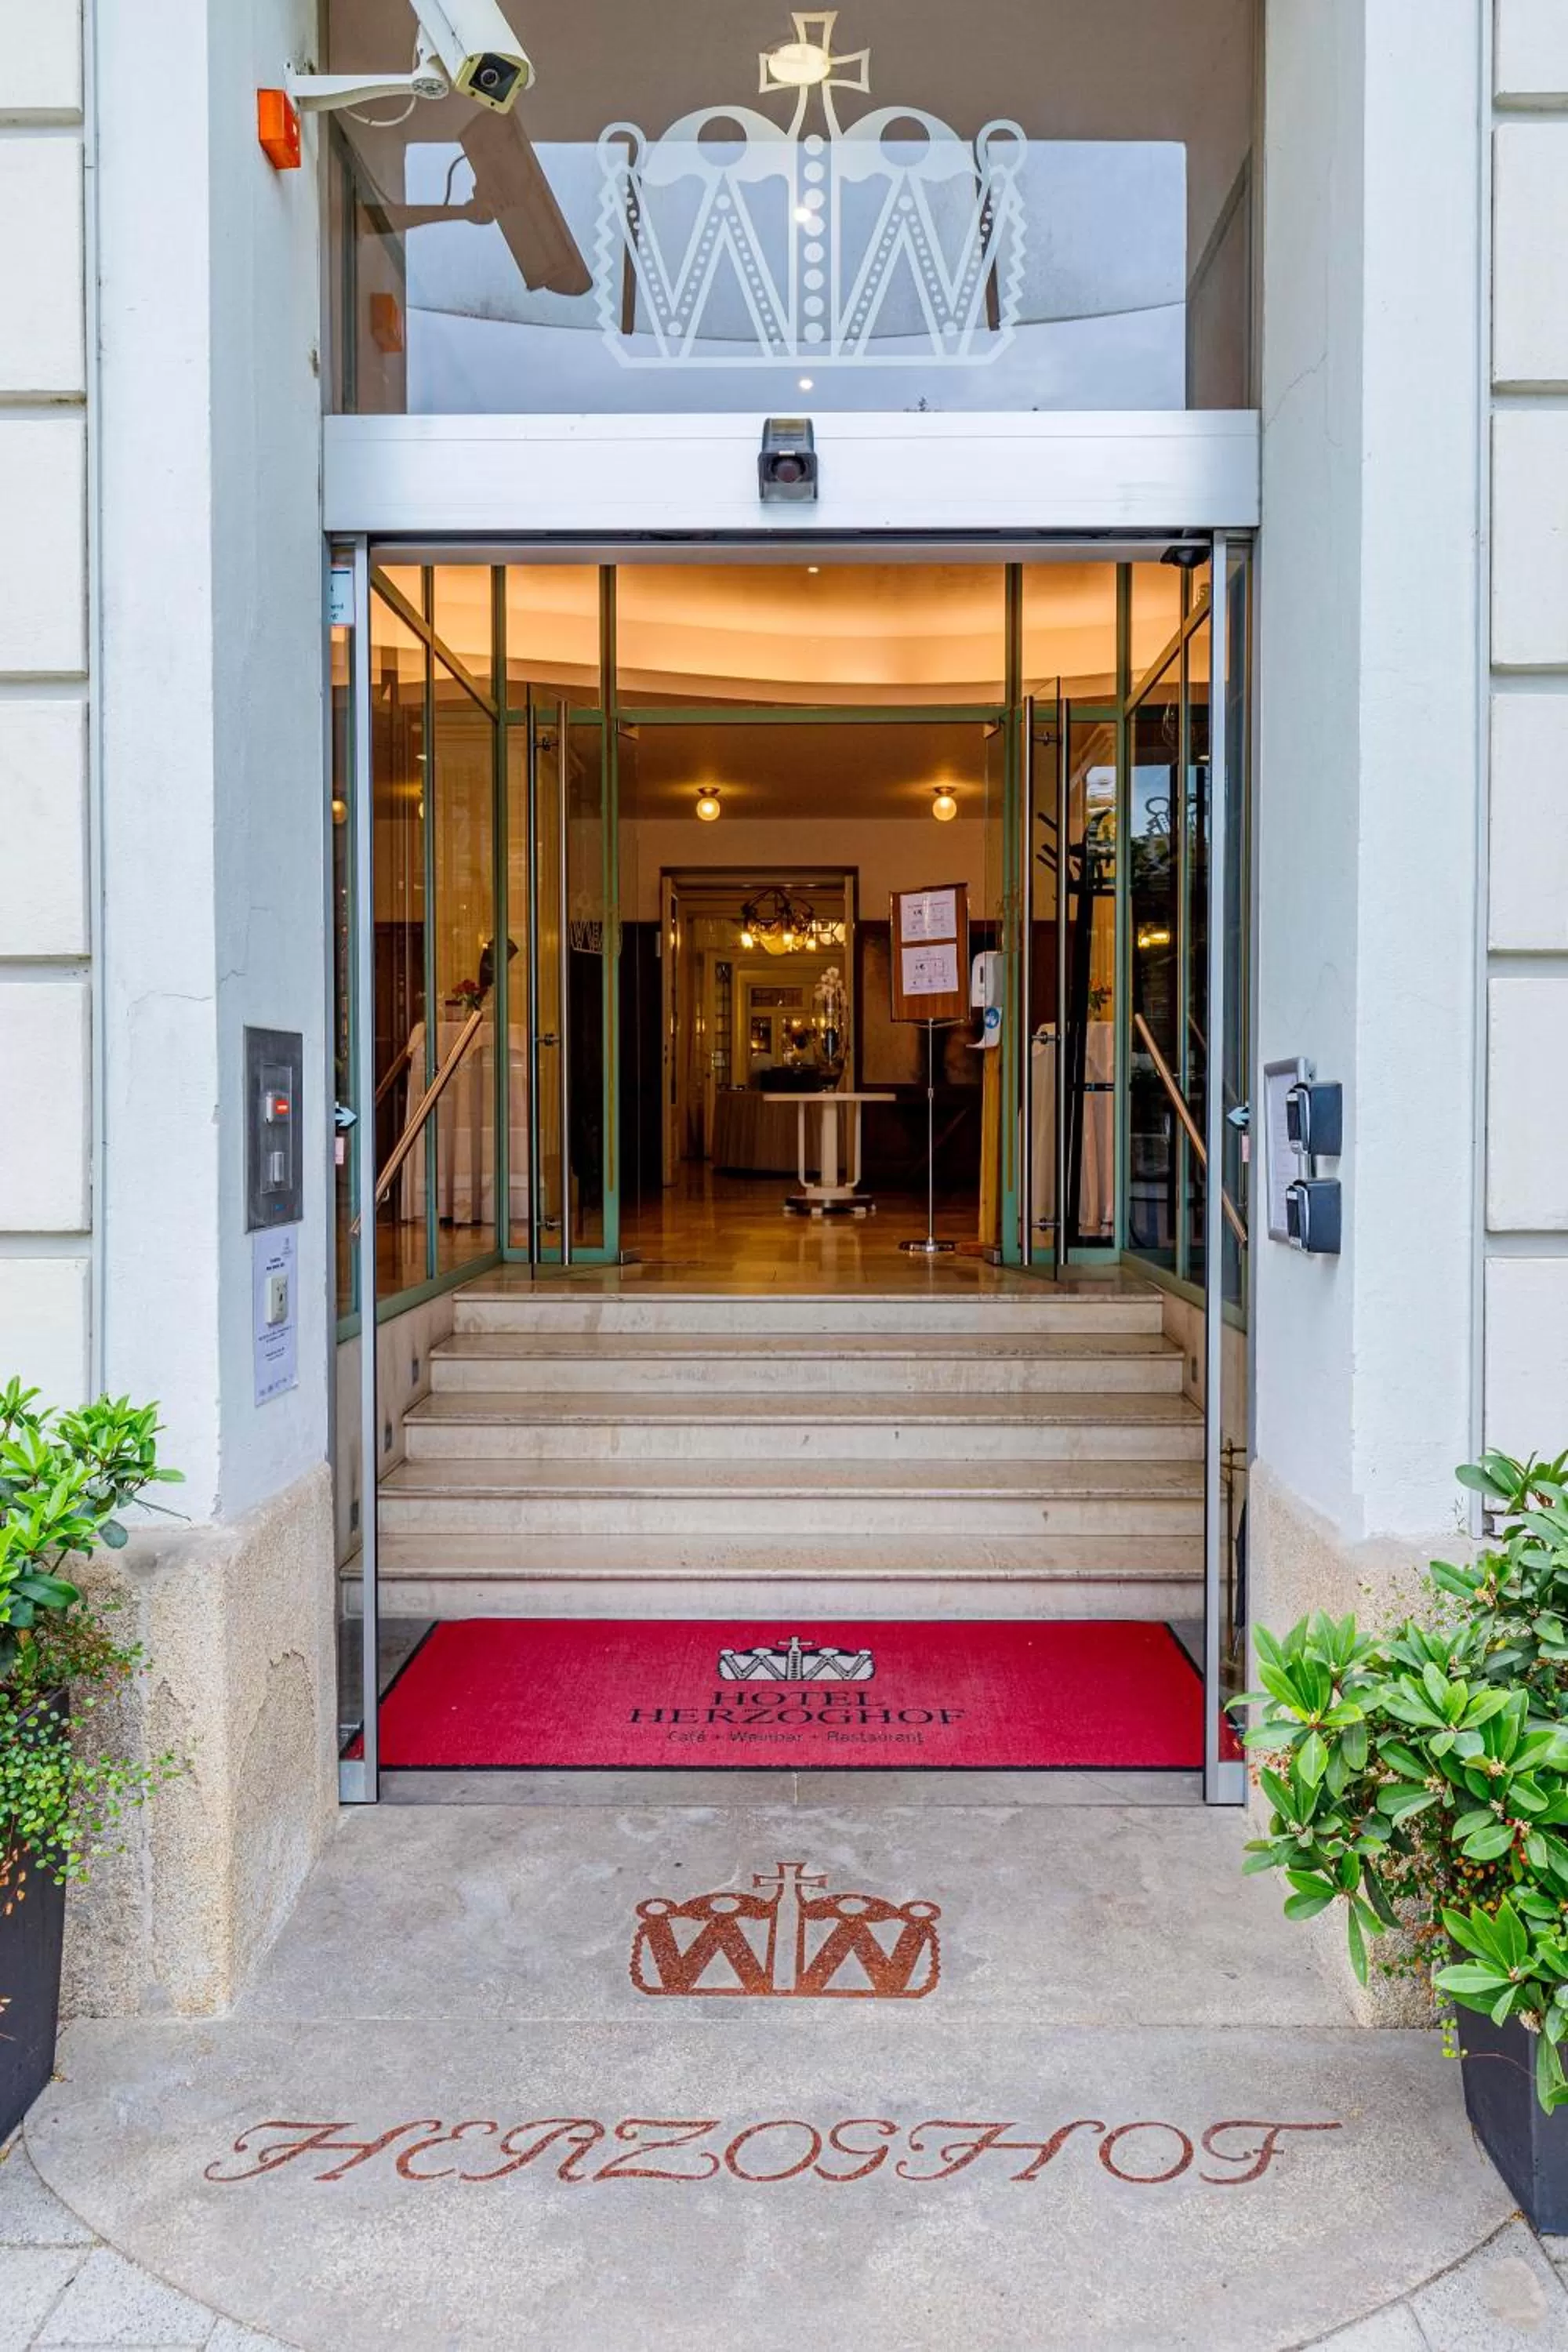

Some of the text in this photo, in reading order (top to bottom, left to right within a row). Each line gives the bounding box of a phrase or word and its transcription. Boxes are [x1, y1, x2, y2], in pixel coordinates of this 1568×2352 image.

[713, 1691, 884, 1707] HOTEL
[628, 1708, 965, 1724] HERZOGHOF
[204, 2118, 1343, 2185] HERZOGHOF
